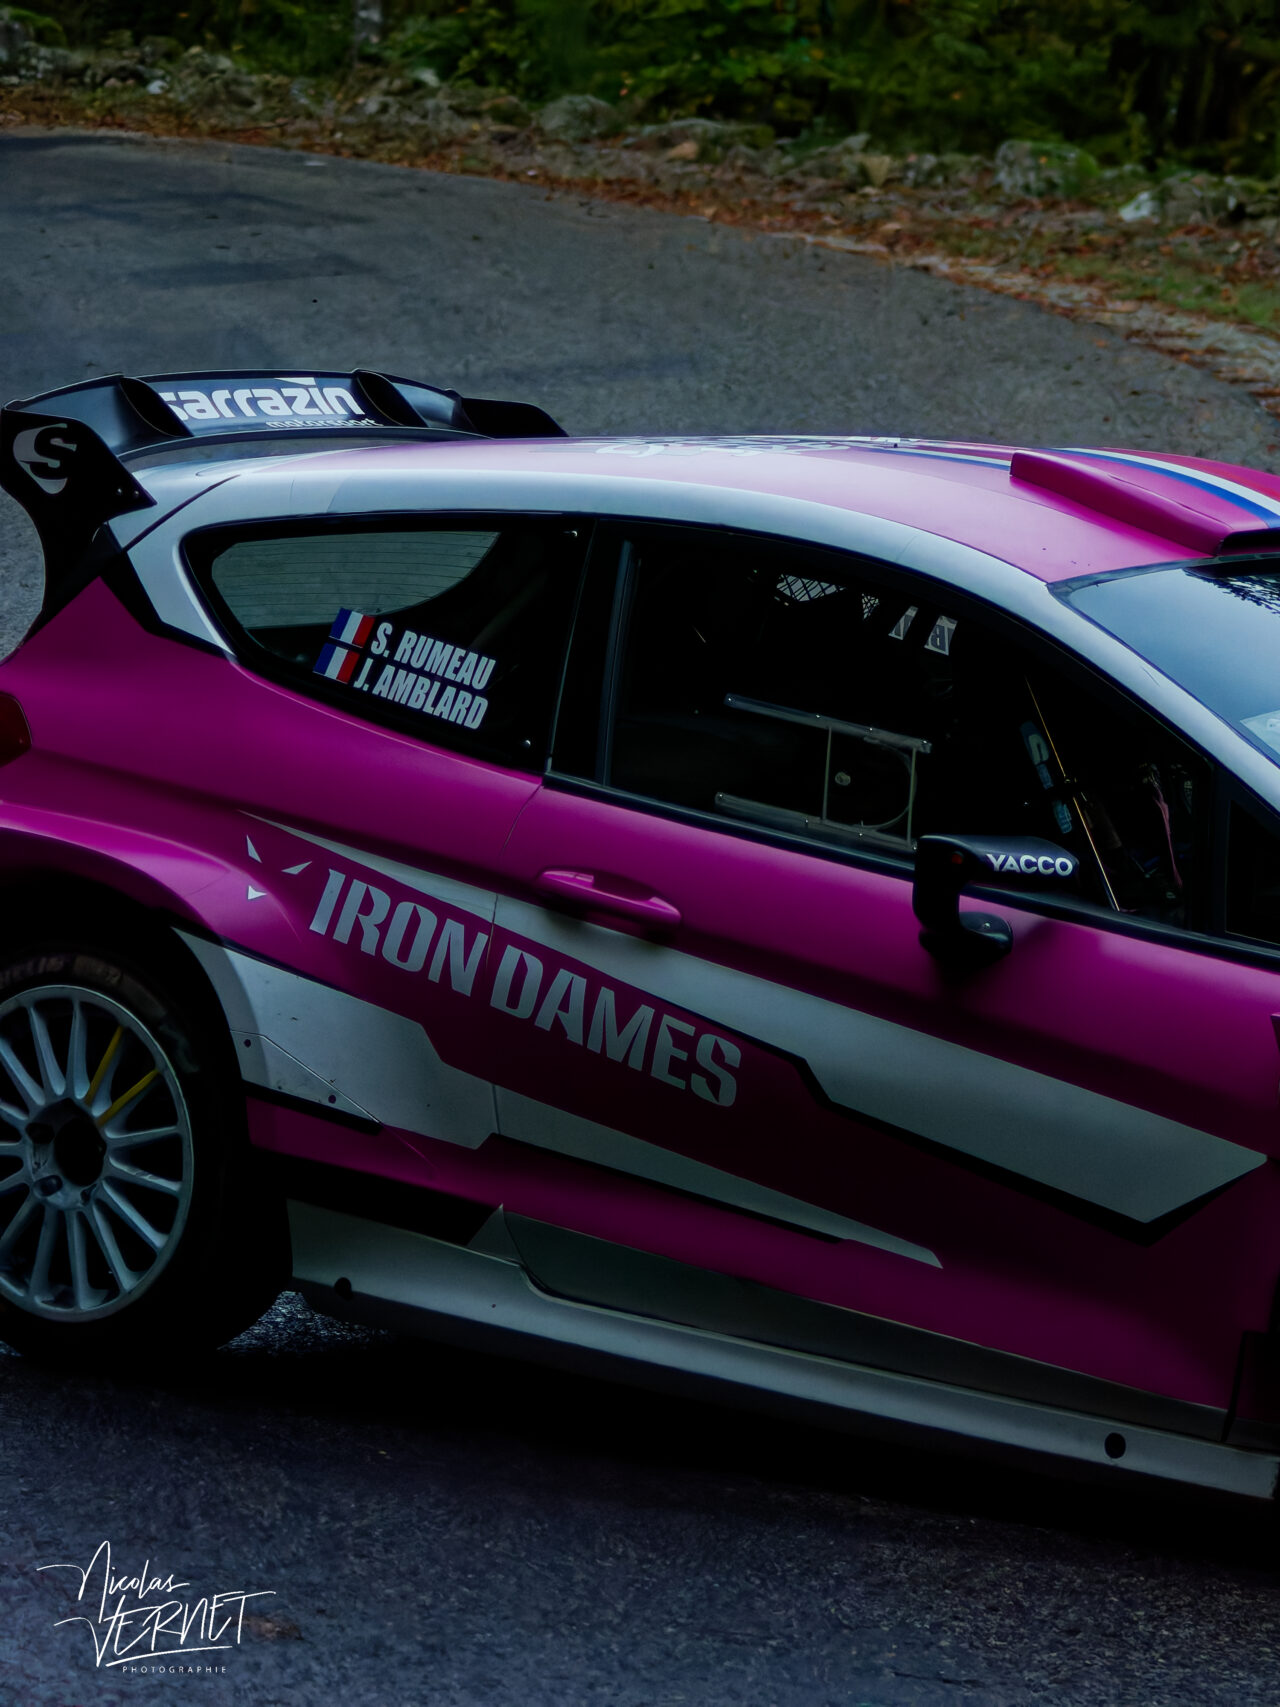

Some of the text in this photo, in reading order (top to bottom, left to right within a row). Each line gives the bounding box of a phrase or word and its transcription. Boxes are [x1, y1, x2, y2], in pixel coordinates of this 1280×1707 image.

[371, 622, 497, 690] S. RUMEAU
[353, 657, 489, 730] J. AMBLARD
[986, 853, 1073, 876] YACCO
[309, 868, 742, 1108] IRON DAMES
